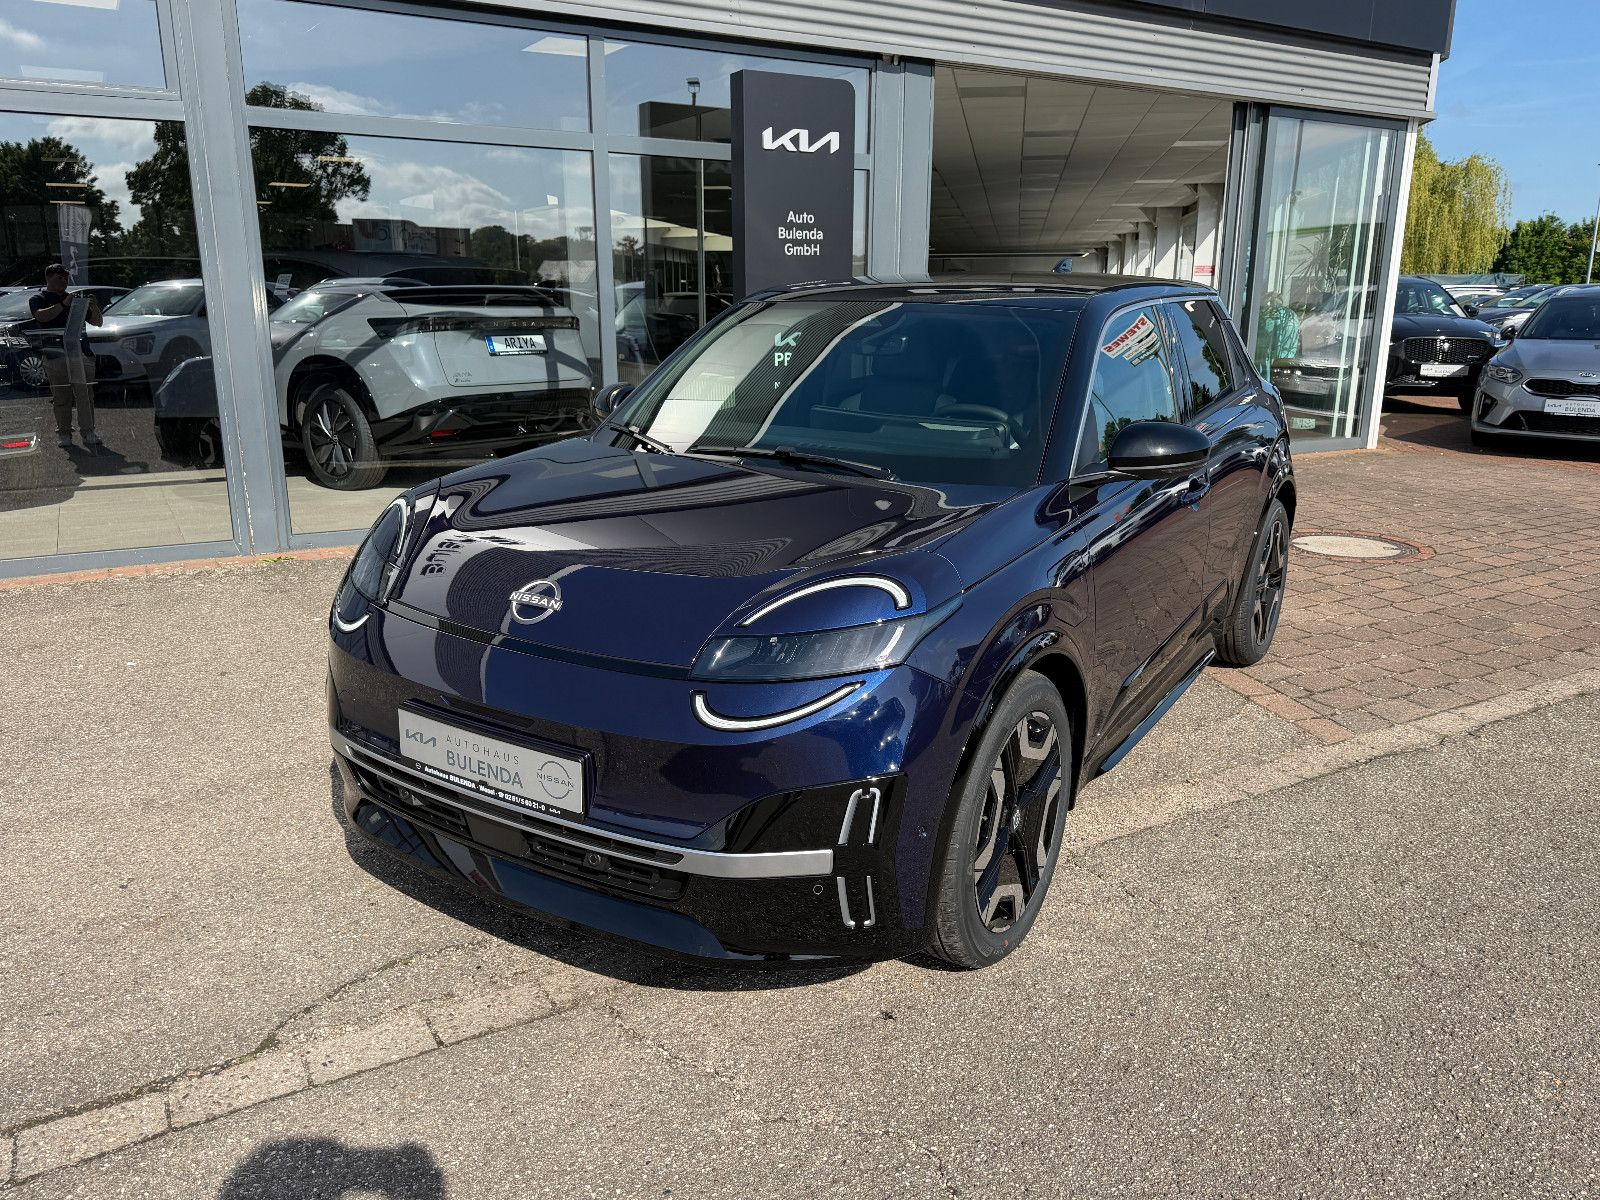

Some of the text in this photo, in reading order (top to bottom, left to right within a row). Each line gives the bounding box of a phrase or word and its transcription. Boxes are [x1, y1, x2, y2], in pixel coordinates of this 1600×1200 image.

[762, 126, 840, 154] KIA
[787, 211, 815, 224] Auto
[778, 227, 824, 240] Bulenda
[784, 244, 820, 256] GmbH
[504, 337, 536, 349] ARIYA
[509, 591, 561, 609] NISSAN
[406, 728, 437, 748] KIA
[446, 735, 519, 765] AUTOHAUS
[424, 765, 449, 780] Autohaus
[449, 774, 476, 789] BULENDA
[446, 750, 524, 789] BULENDA
[536, 772, 574, 788] NISSAN
